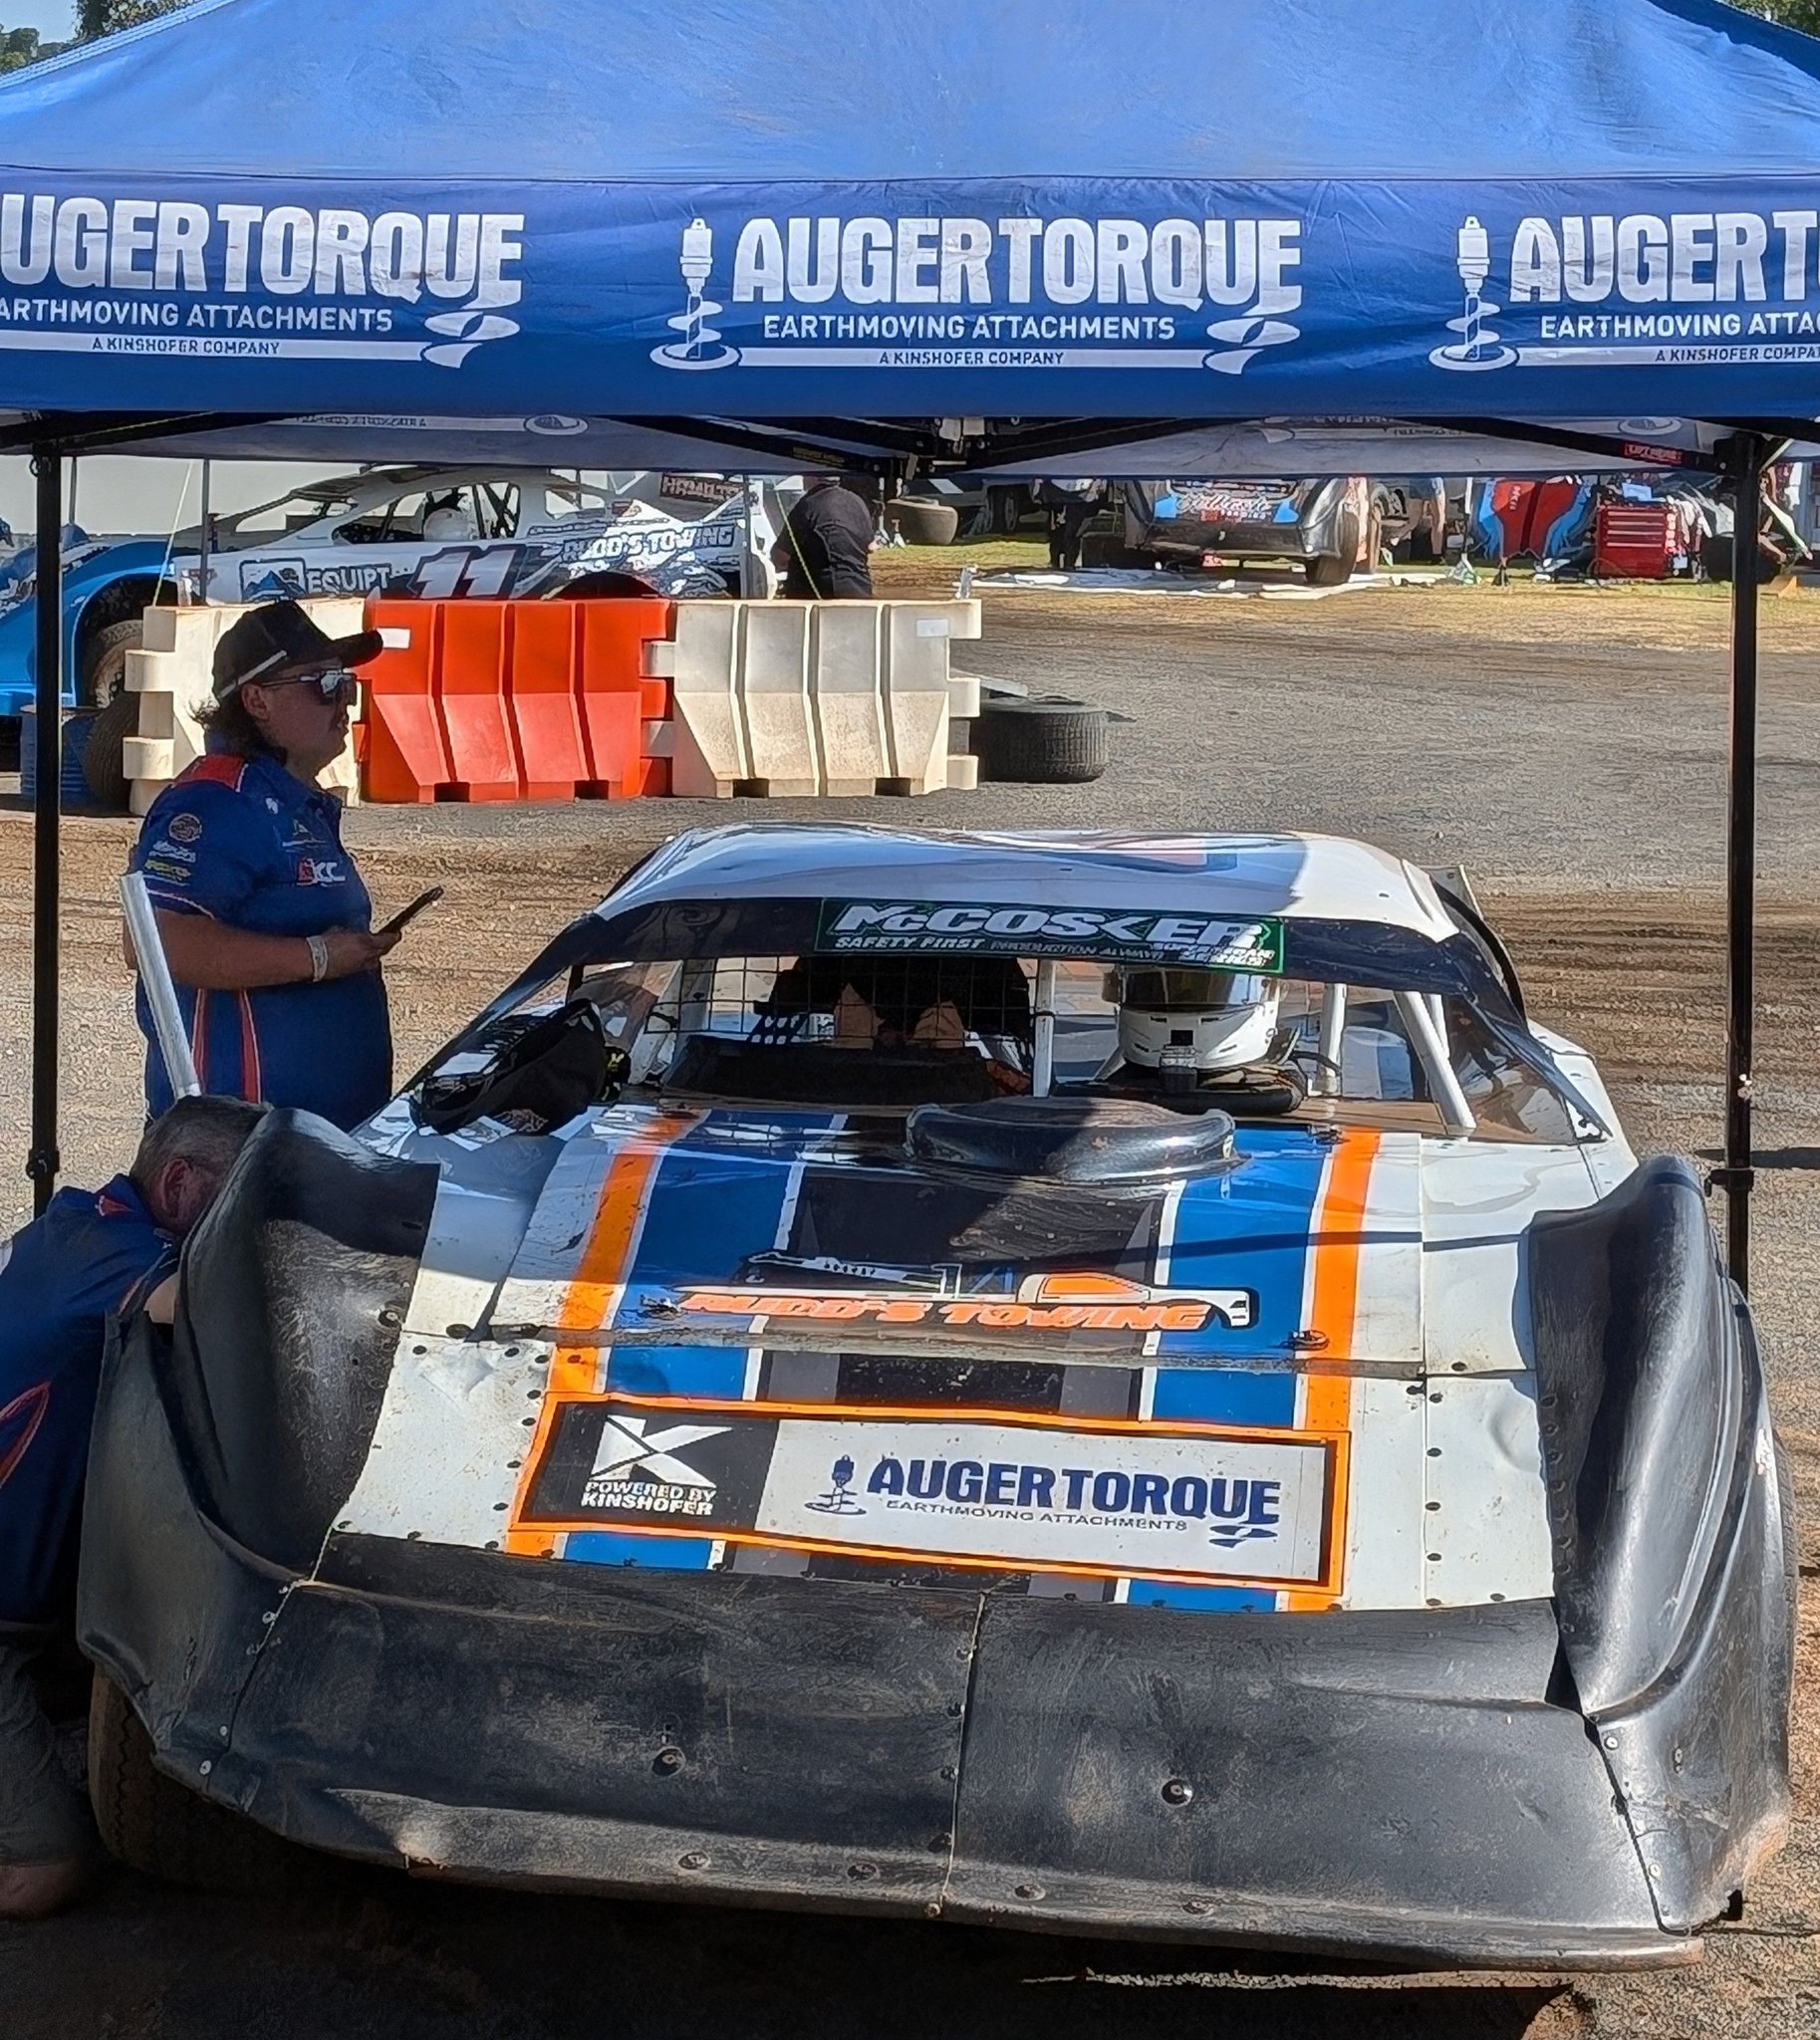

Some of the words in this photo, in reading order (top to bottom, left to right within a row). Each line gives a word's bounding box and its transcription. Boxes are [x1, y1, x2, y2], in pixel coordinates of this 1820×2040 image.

[186, 303, 392, 332] ATTACHMENTS
[764, 315, 965, 340] EARTHMOVING
[971, 315, 1175, 340] ATTACHMENTS
[1541, 314, 1741, 338] EARTHMOVING
[1747, 312, 1820, 336] ATTA
[92, 337, 104, 350] A
[107, 337, 198, 353] KINSHOFER
[203, 340, 280, 355] COMPANY
[879, 352, 890, 365] A
[895, 352, 983, 365] KINSHOFER
[988, 352, 1064, 365] COMPANY
[1655, 350, 1667, 362] A
[1670, 349, 1760, 362] KINSHOFER
[1763, 347, 1820, 360] COMPA
[306, 565, 390, 595] EQUIPT
[409, 547, 520, 599] 11
[835, 936, 917, 948] SAFETY
[919, 937, 985, 949] FIRST
[678, 1294, 933, 1322] RUDD'S
[938, 1302, 1212, 1330] TOWING
[581, 1492, 713, 1515] KINSHOFER
[585, 1481, 683, 1499] POWERED
[688, 1487, 716, 1502] BY
[887, 1500, 1033, 1521] EARTHMOVING
[1039, 1513, 1187, 1531] ATTACHMENTS
